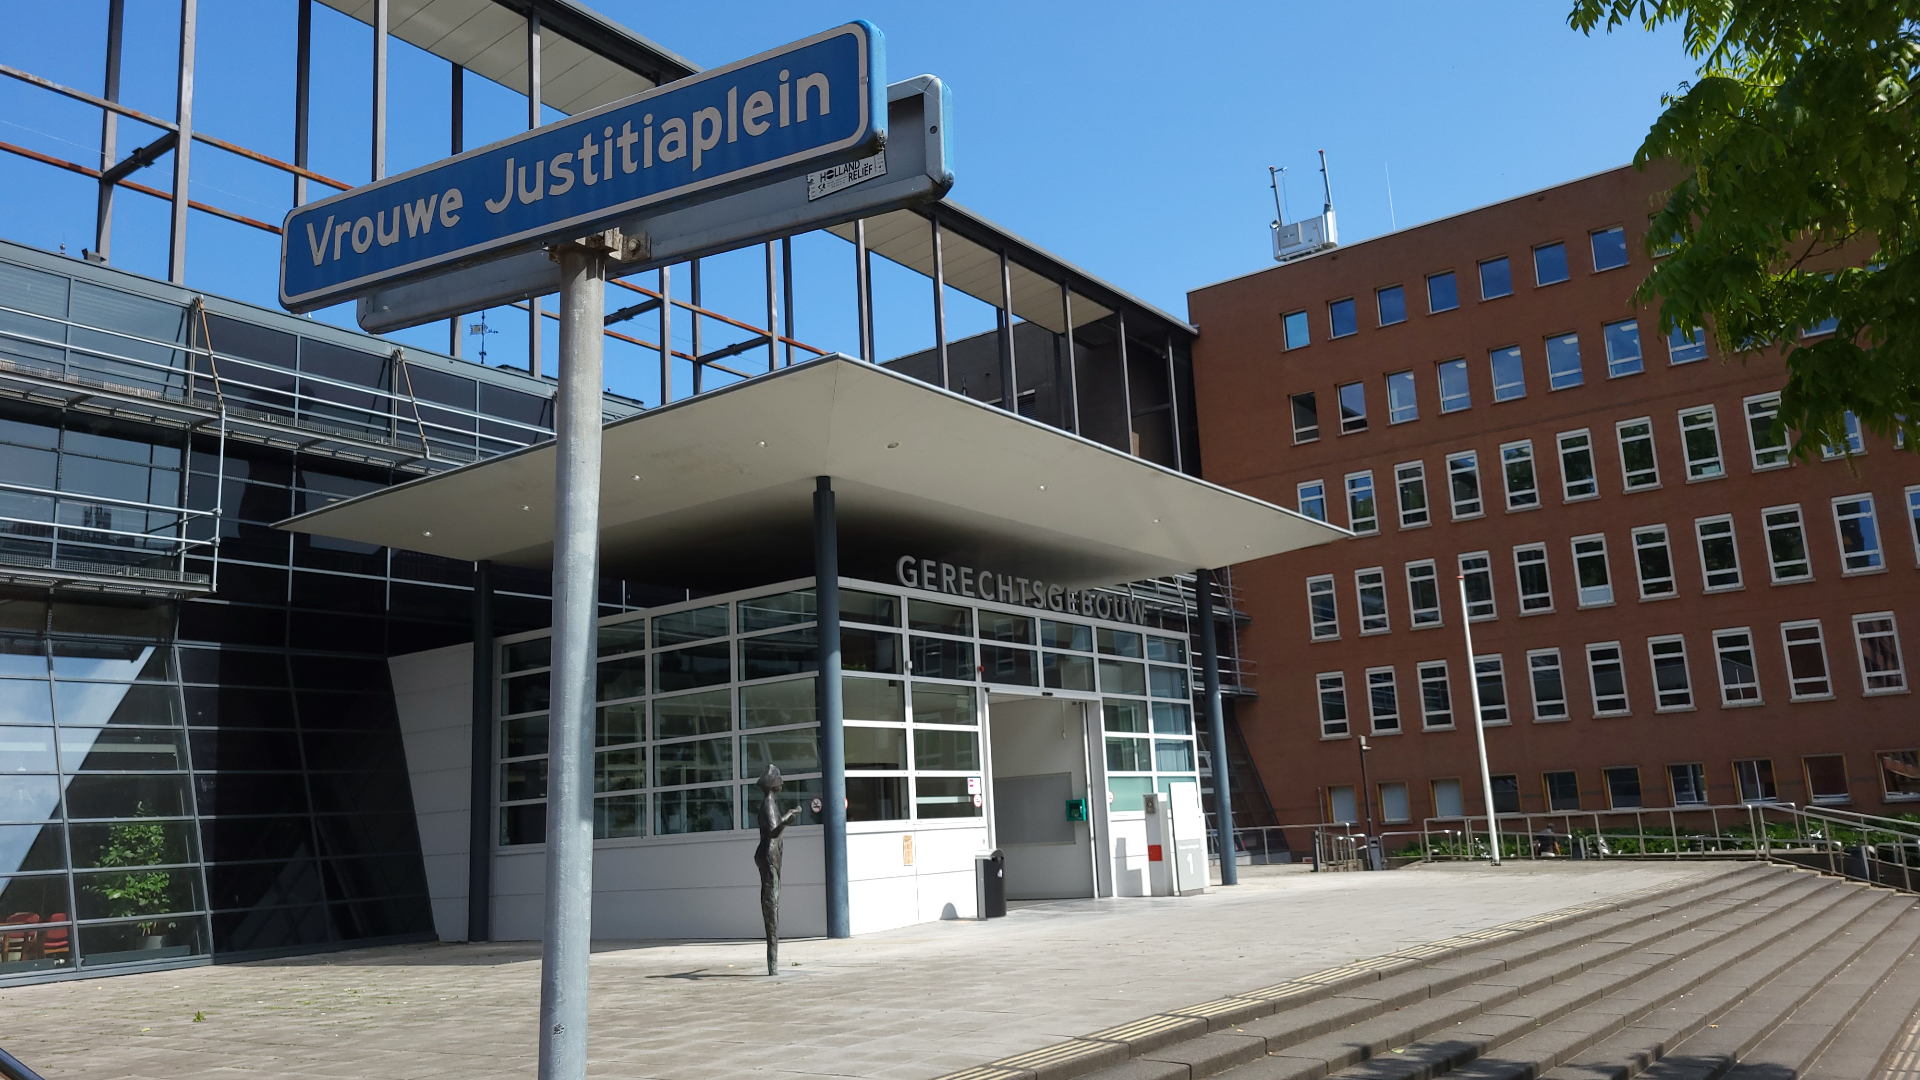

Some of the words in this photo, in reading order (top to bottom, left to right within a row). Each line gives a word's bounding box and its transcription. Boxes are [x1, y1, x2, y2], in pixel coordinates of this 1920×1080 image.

[306, 188, 463, 267] Vrouwe
[484, 69, 830, 214] Justitiaplein
[820, 160, 861, 182] HOLLAND
[848, 163, 873, 182] RELIËF
[897, 555, 1147, 625] GERECHTSGEBOUW
[1187, 853, 1194, 875] 1
